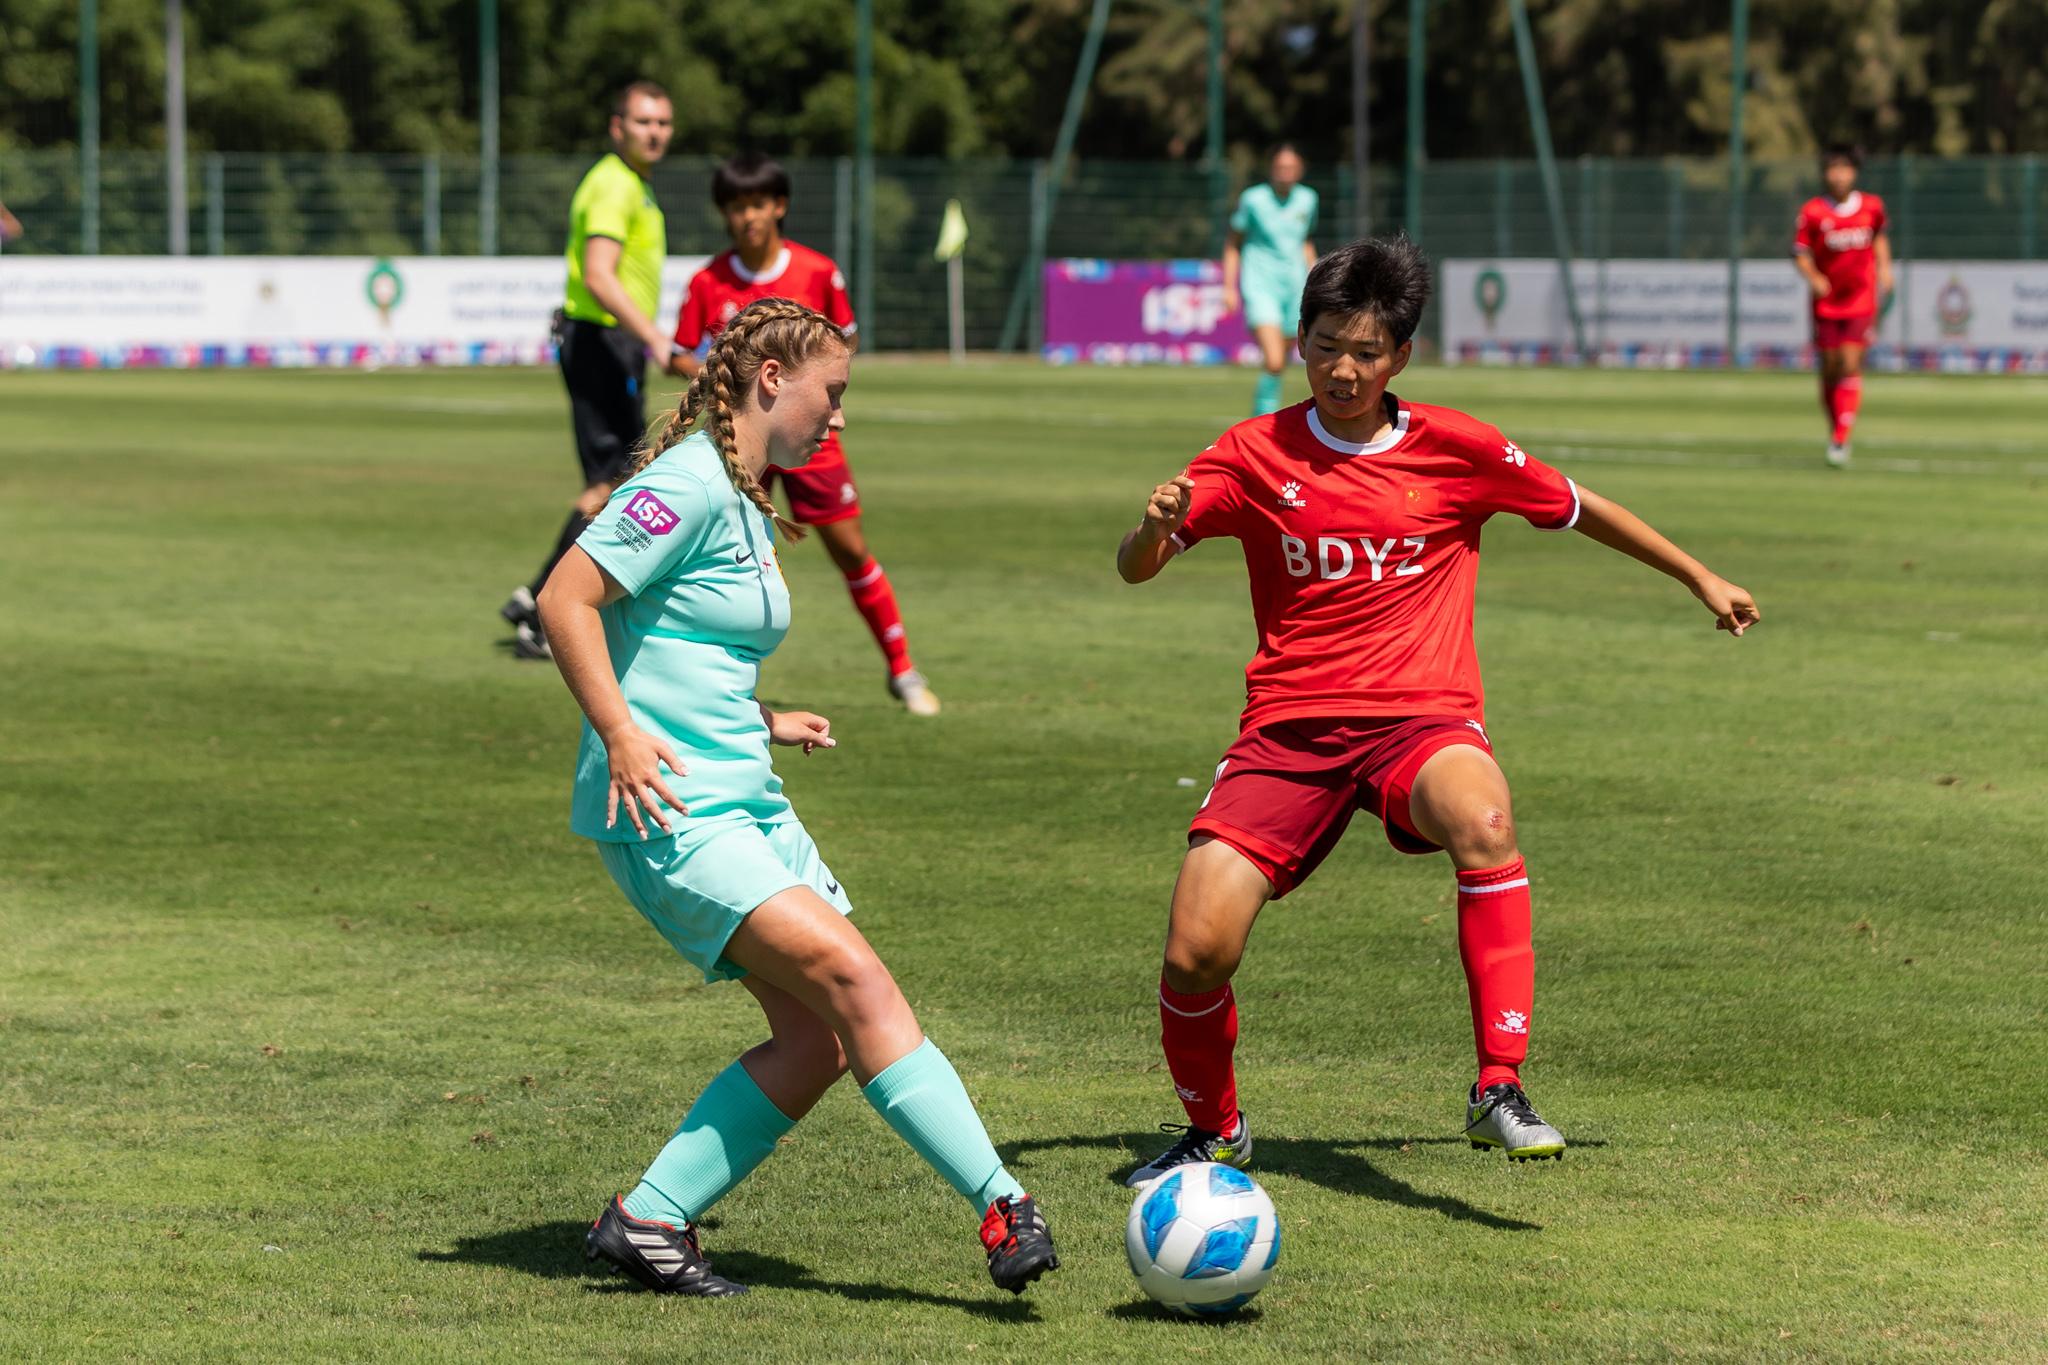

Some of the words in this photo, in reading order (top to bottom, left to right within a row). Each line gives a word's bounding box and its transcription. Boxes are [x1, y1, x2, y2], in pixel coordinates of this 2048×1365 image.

[1141, 283, 1226, 336] ISF
[631, 497, 673, 529] ISF
[614, 529, 640, 554] FEDERATION
[615, 521, 633, 540] SCHOOL
[633, 536, 649, 552] SPORT
[620, 516, 654, 546] INTERNATIONAL
[1281, 533, 1426, 582] BDYZ
